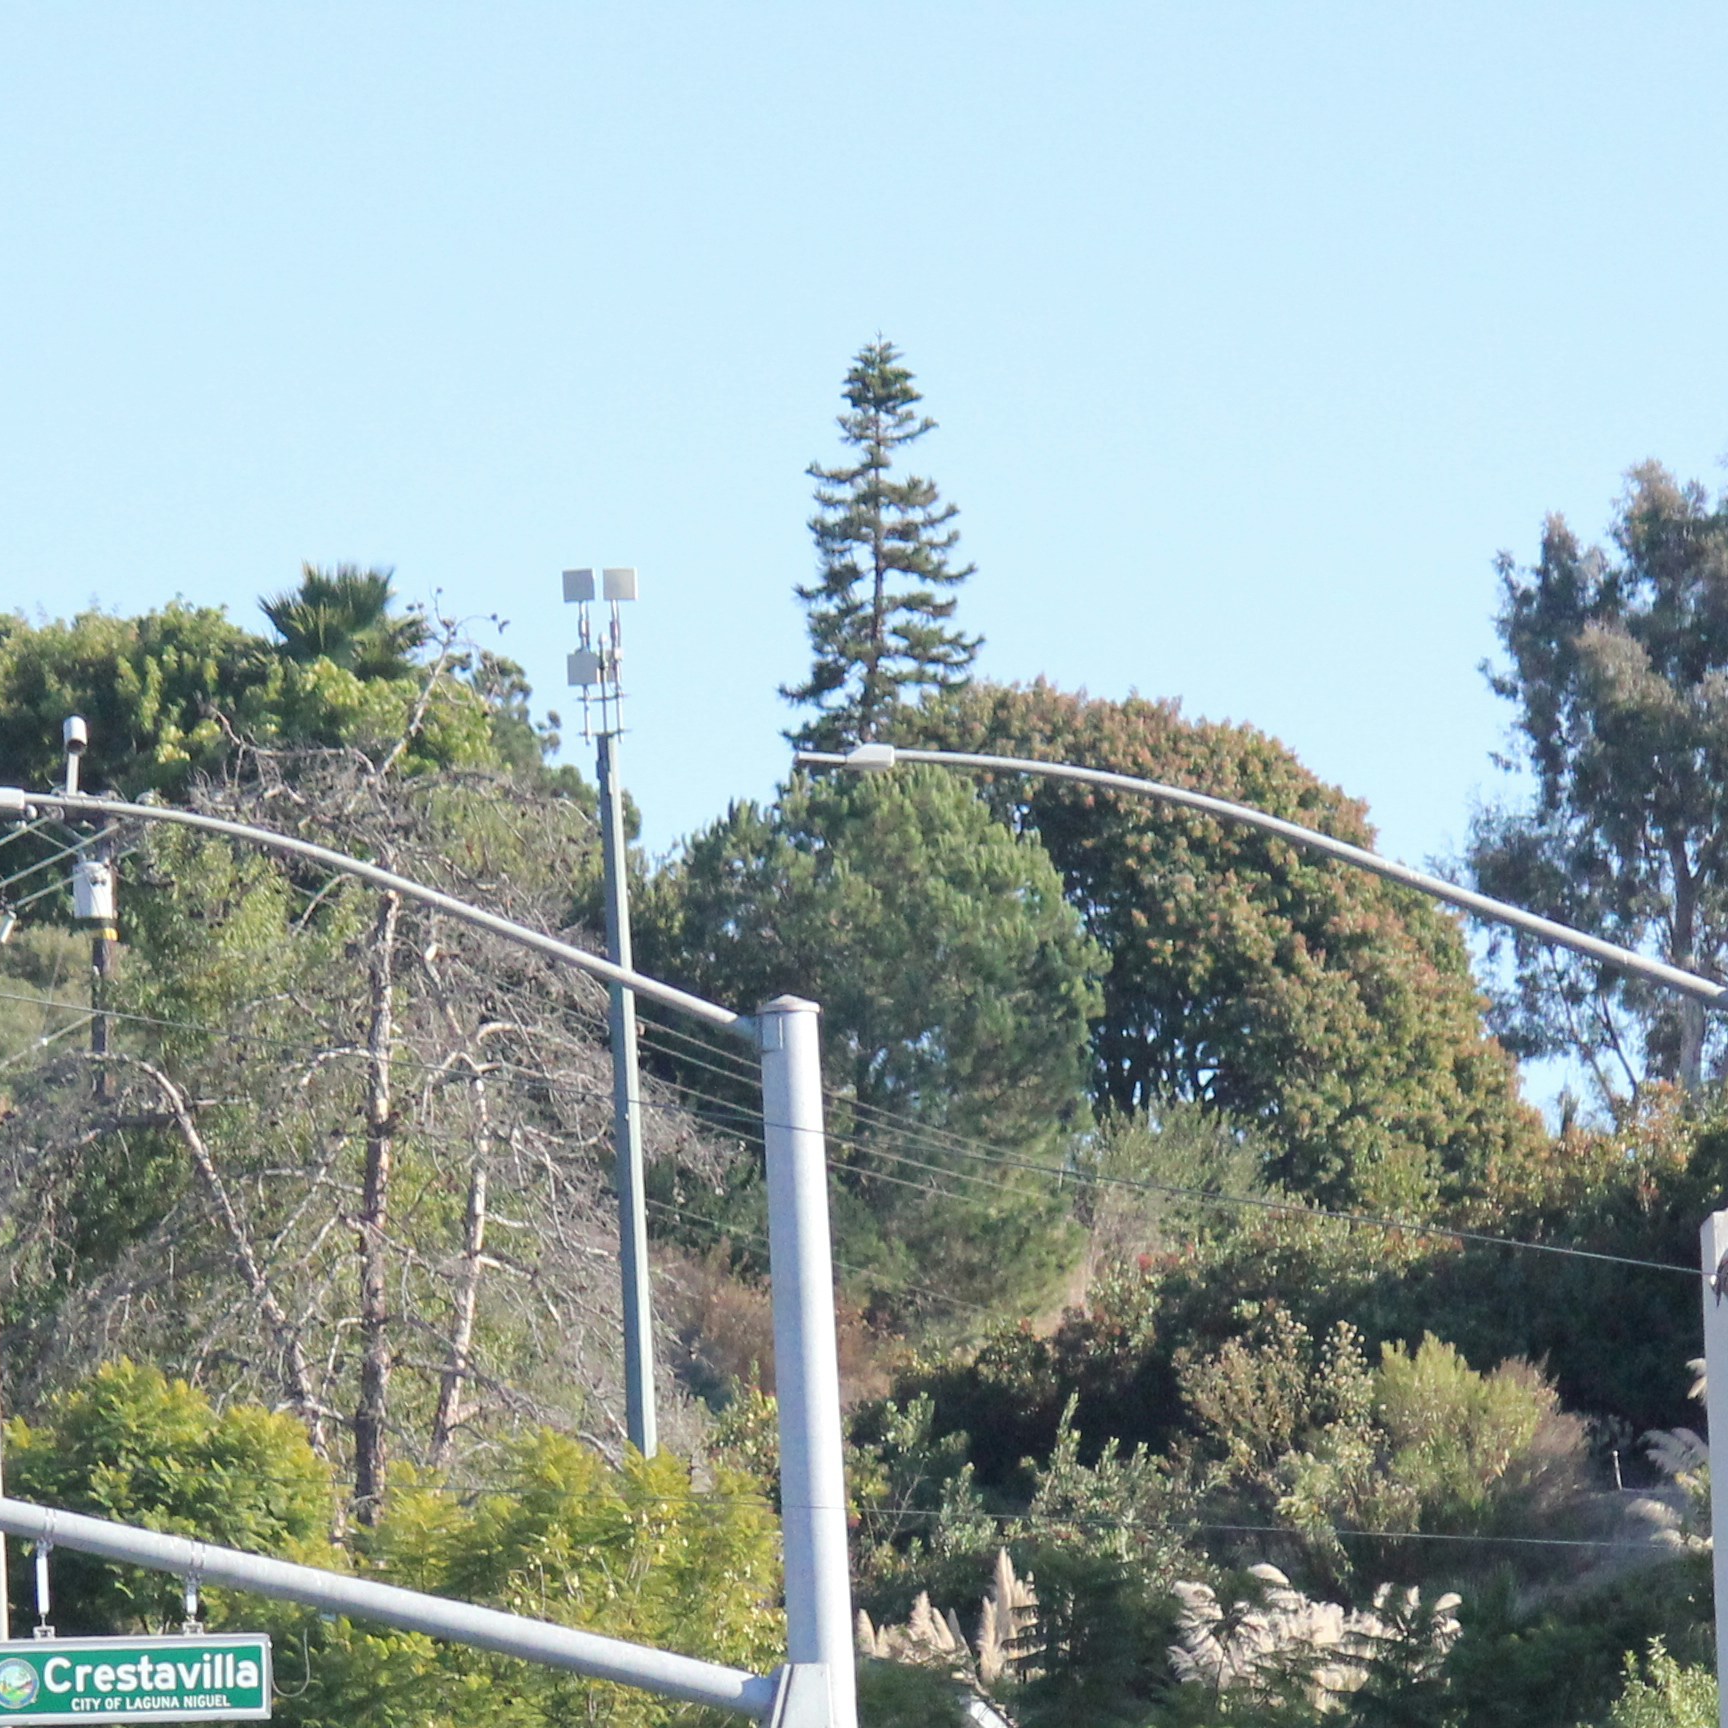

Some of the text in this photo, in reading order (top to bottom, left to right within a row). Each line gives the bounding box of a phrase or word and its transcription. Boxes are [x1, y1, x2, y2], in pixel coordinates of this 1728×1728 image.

[43, 1653, 259, 1693] Crestavilla
[71, 1694, 232, 1711] CITY OF LAGUNA NIGUEL
